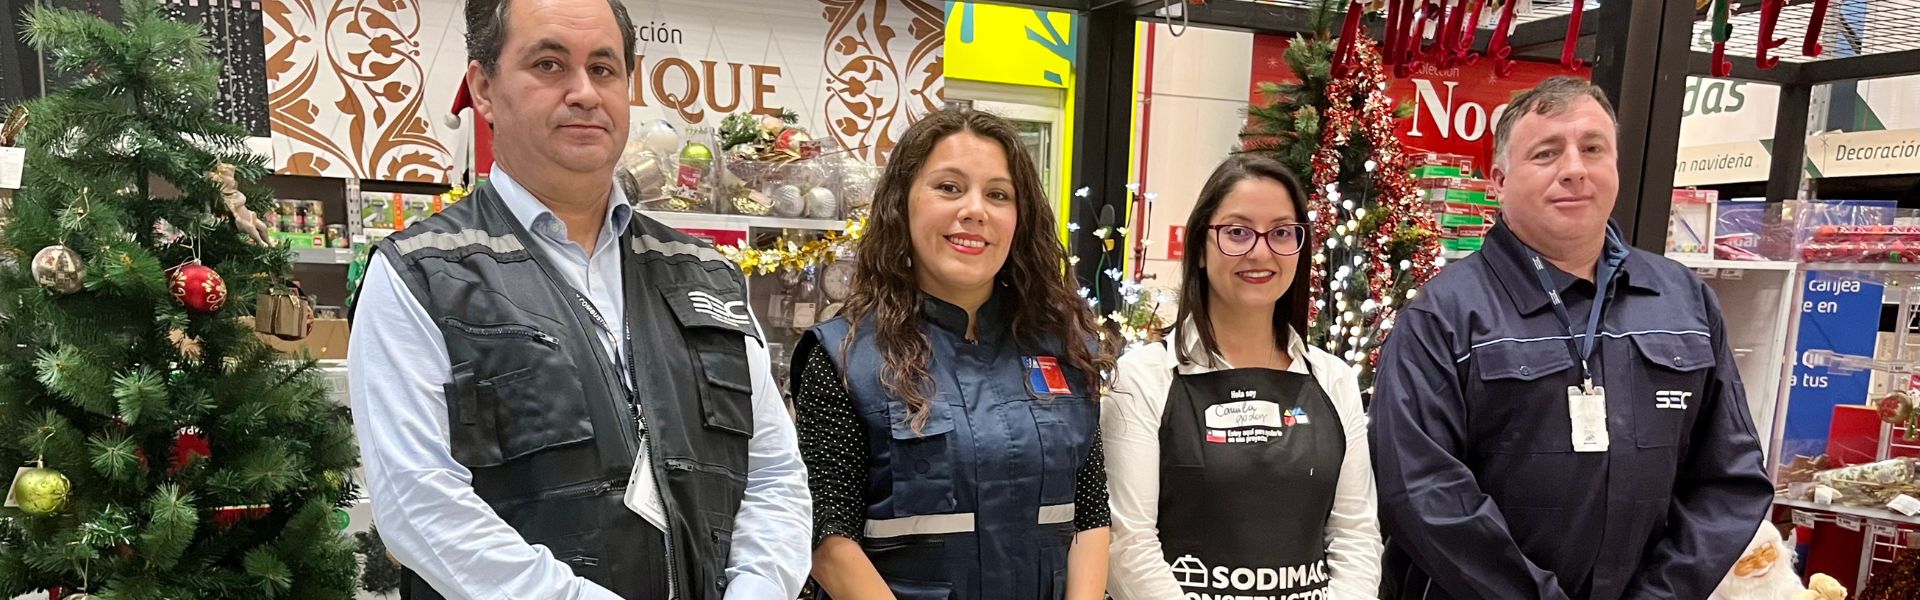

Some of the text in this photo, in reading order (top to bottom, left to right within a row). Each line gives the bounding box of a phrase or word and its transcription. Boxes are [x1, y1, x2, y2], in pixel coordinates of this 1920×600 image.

[635, 21, 683, 44] cción
[1690, 153, 1753, 172] navideña
[1817, 301, 1838, 313] en
[1802, 373, 1828, 388] tus
[1230, 389, 1257, 399] Hola soy
[1655, 390, 1692, 410] SEC
